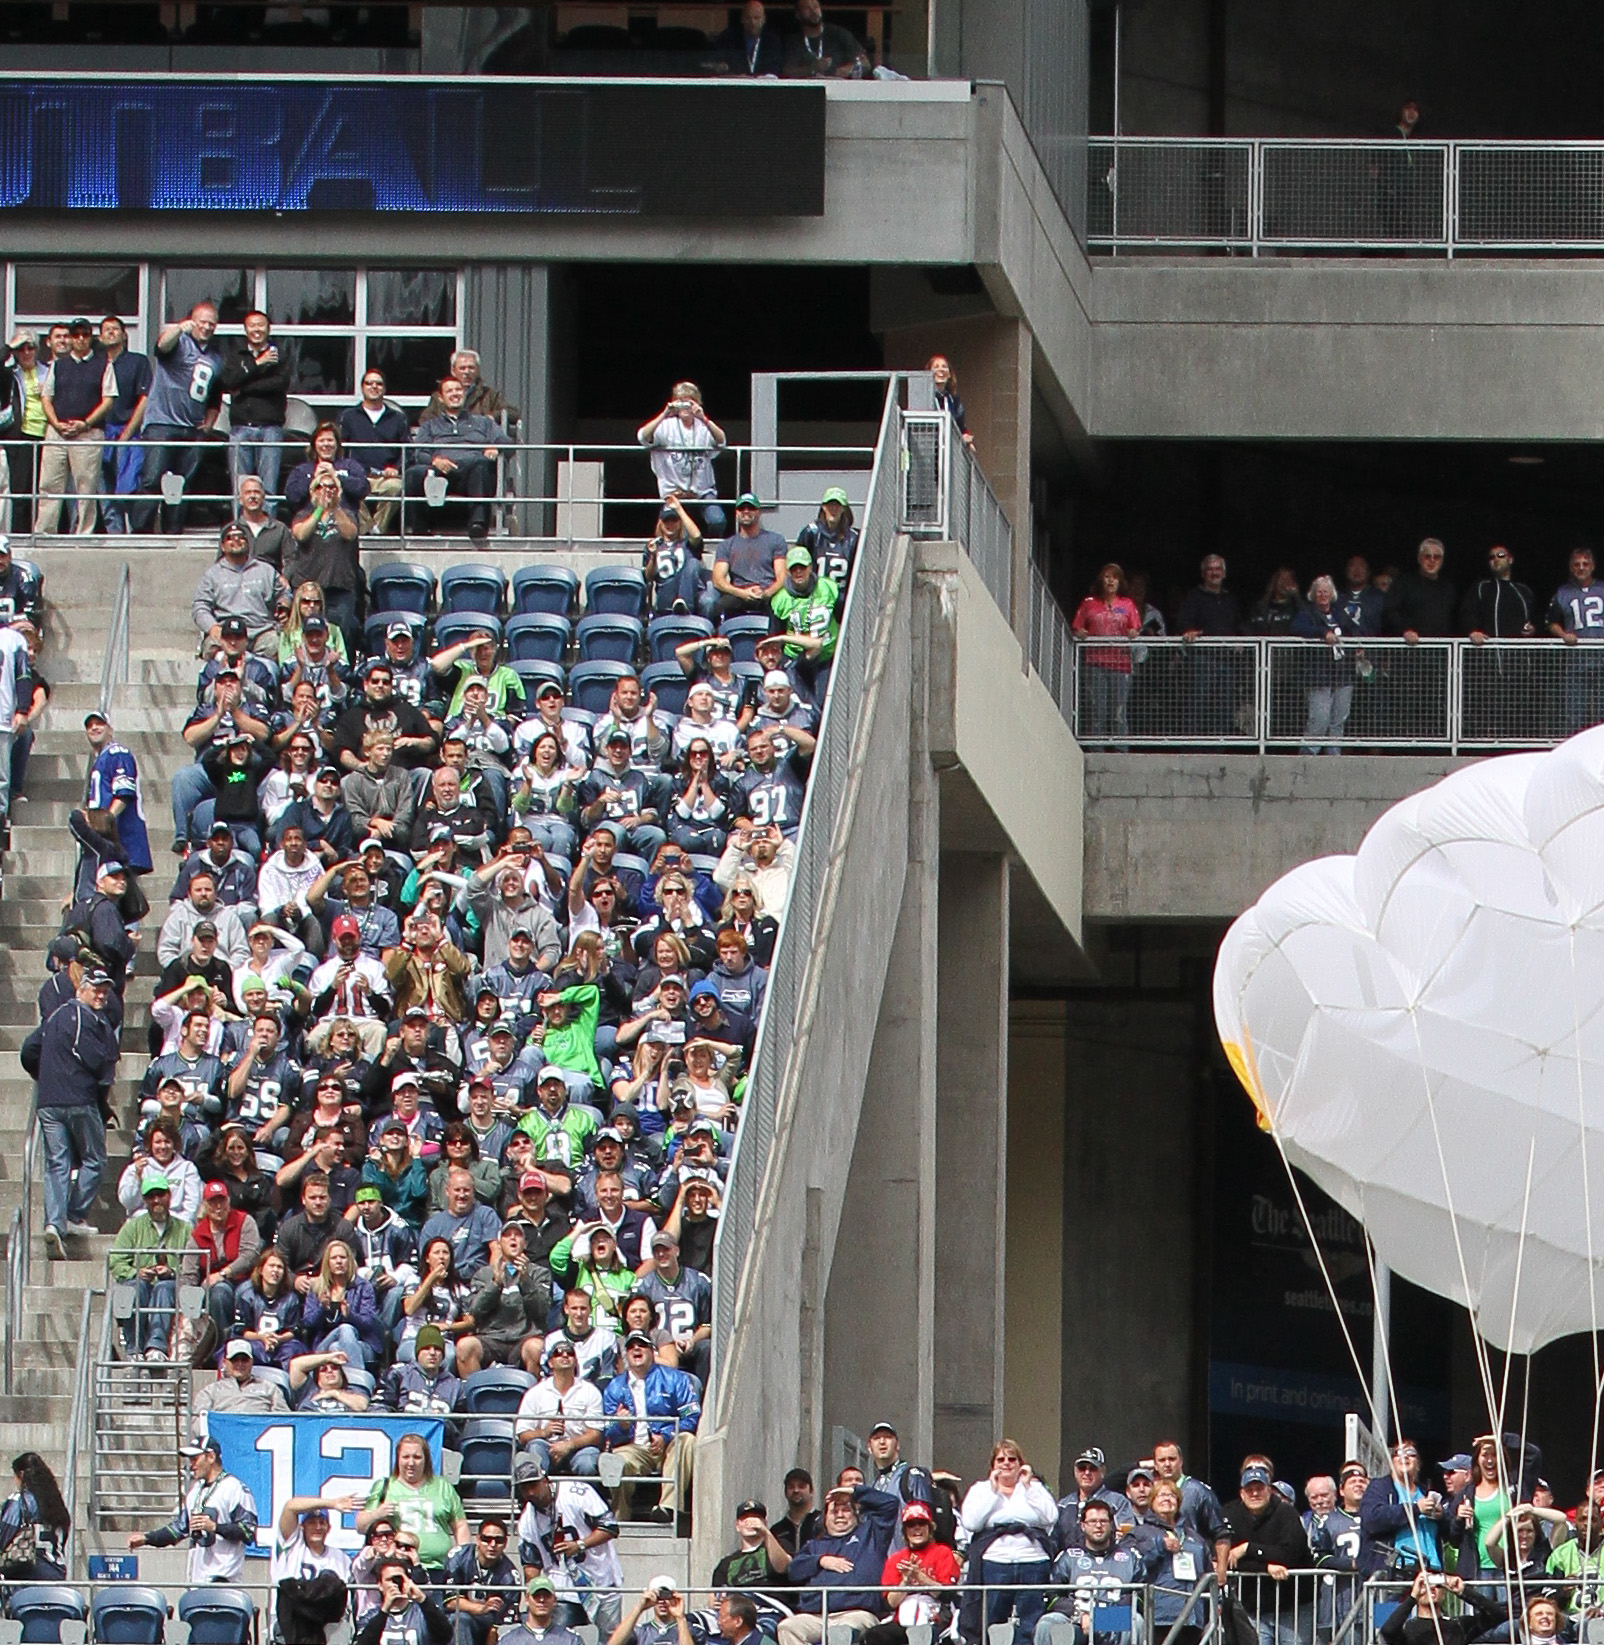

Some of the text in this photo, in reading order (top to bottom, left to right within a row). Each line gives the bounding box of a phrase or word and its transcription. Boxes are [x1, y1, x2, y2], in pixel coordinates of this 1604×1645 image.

[188, 363, 213, 403] 8
[789, 605, 832, 638] 12
[1570, 596, 1604, 630] 12
[749, 786, 788, 826] 97
[654, 1303, 694, 1343] 12
[1247, 1380, 1278, 1404] print
[1281, 1385, 1307, 1405] and
[252, 1424, 394, 1548] 12
[399, 1500, 437, 1534] 51
